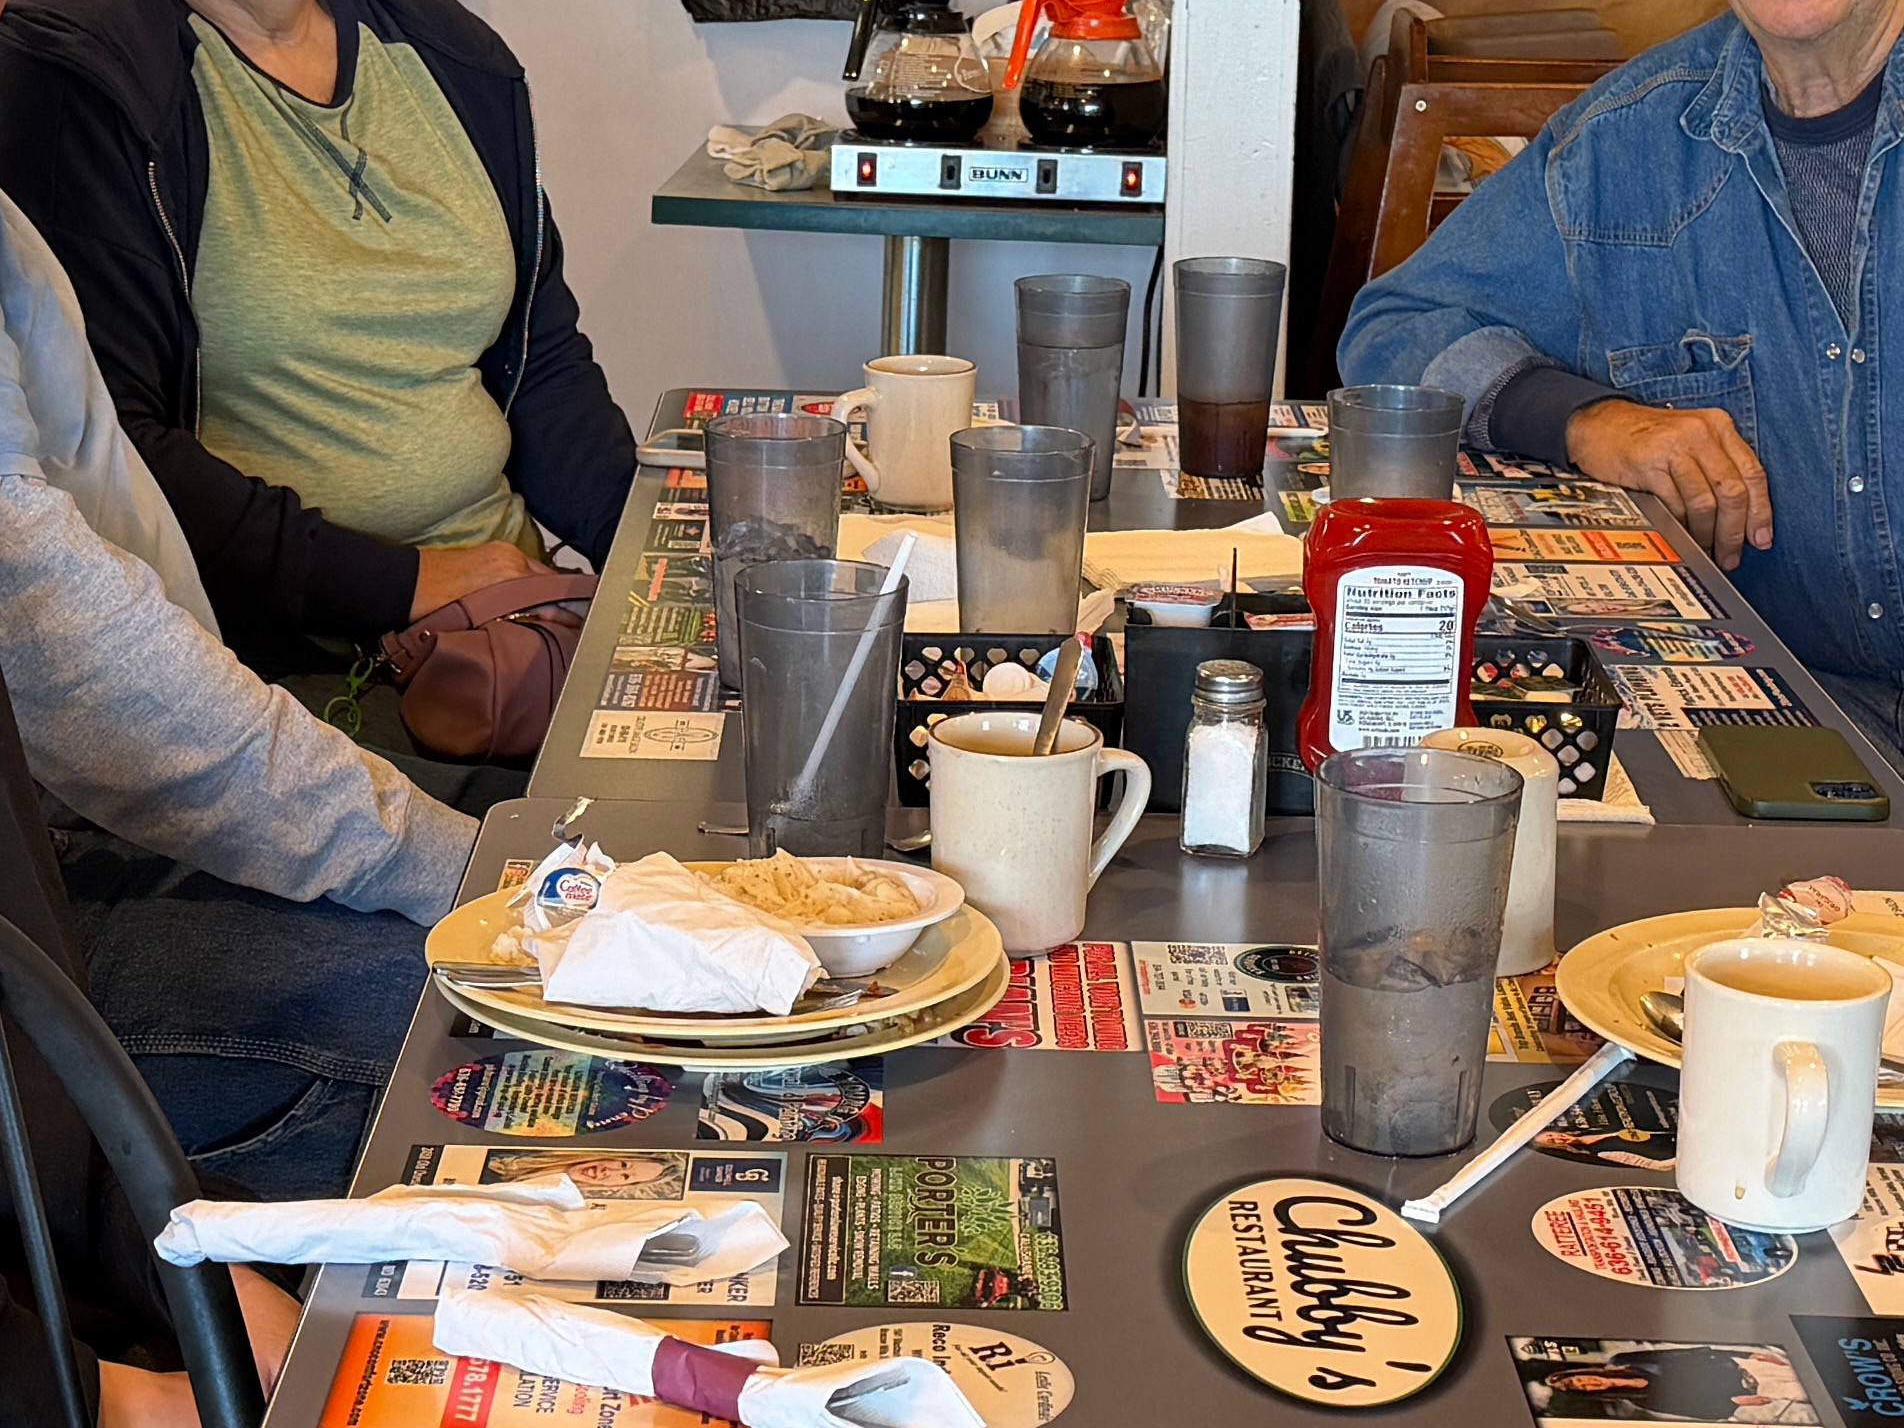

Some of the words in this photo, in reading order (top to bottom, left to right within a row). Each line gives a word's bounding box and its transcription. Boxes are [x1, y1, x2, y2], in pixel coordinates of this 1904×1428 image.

[973, 169, 1021, 180] BUNN
[1347, 588, 1412, 598] Nutrition
[1418, 589, 1455, 598] Facts
[1345, 622, 1383, 632] Calories
[1439, 621, 1454, 631] 20
[1545, 1211, 1581, 1257] RATTEREE
[1582, 1197, 1633, 1275] 636-614-9451
[1228, 1200, 1282, 1322] RESTAURANT
[1242, 1196, 1432, 1390] Chubby's
[932, 1324, 950, 1352] Reco
